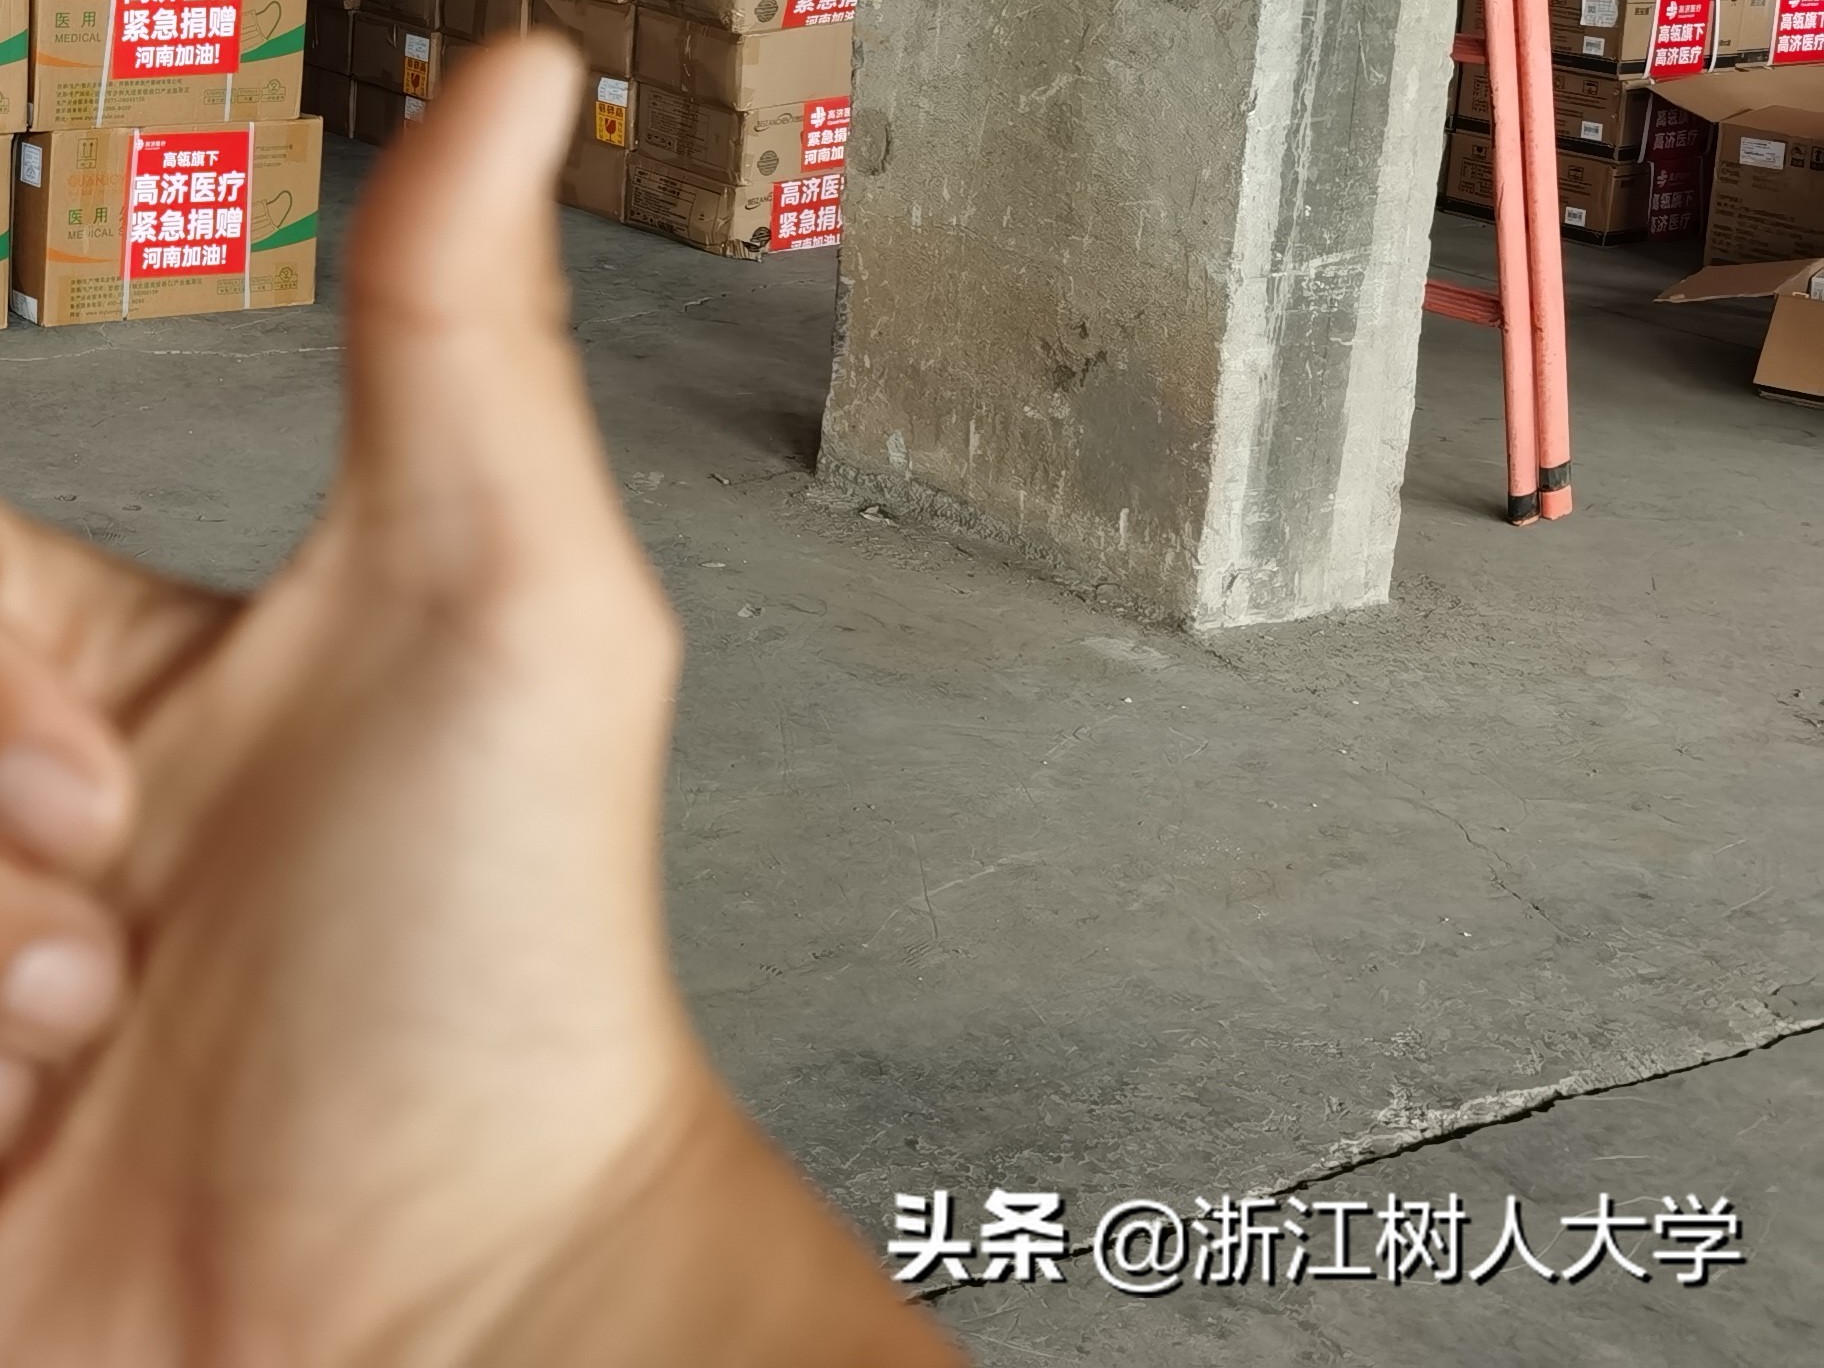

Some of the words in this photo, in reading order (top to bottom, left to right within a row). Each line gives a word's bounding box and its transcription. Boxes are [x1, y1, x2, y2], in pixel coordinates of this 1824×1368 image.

[121, 7, 236, 42] 紧急捐赠
[1658, 23, 1706, 43] 高瓴旗下
[54, 34, 102, 43] MEDICAL
[135, 44, 220, 68] 河南加油!
[1655, 46, 1702, 67] 高济医疗
[163, 150, 219, 169] 高瓴旗下
[804, 146, 844, 165] 河南加
[133, 171, 245, 207] 高济医疗
[781, 174, 844, 207] 高济医
[130, 207, 243, 243] 紧急捐赠
[778, 206, 842, 238] 紧急捐
[142, 246, 227, 269] 河南加油!
